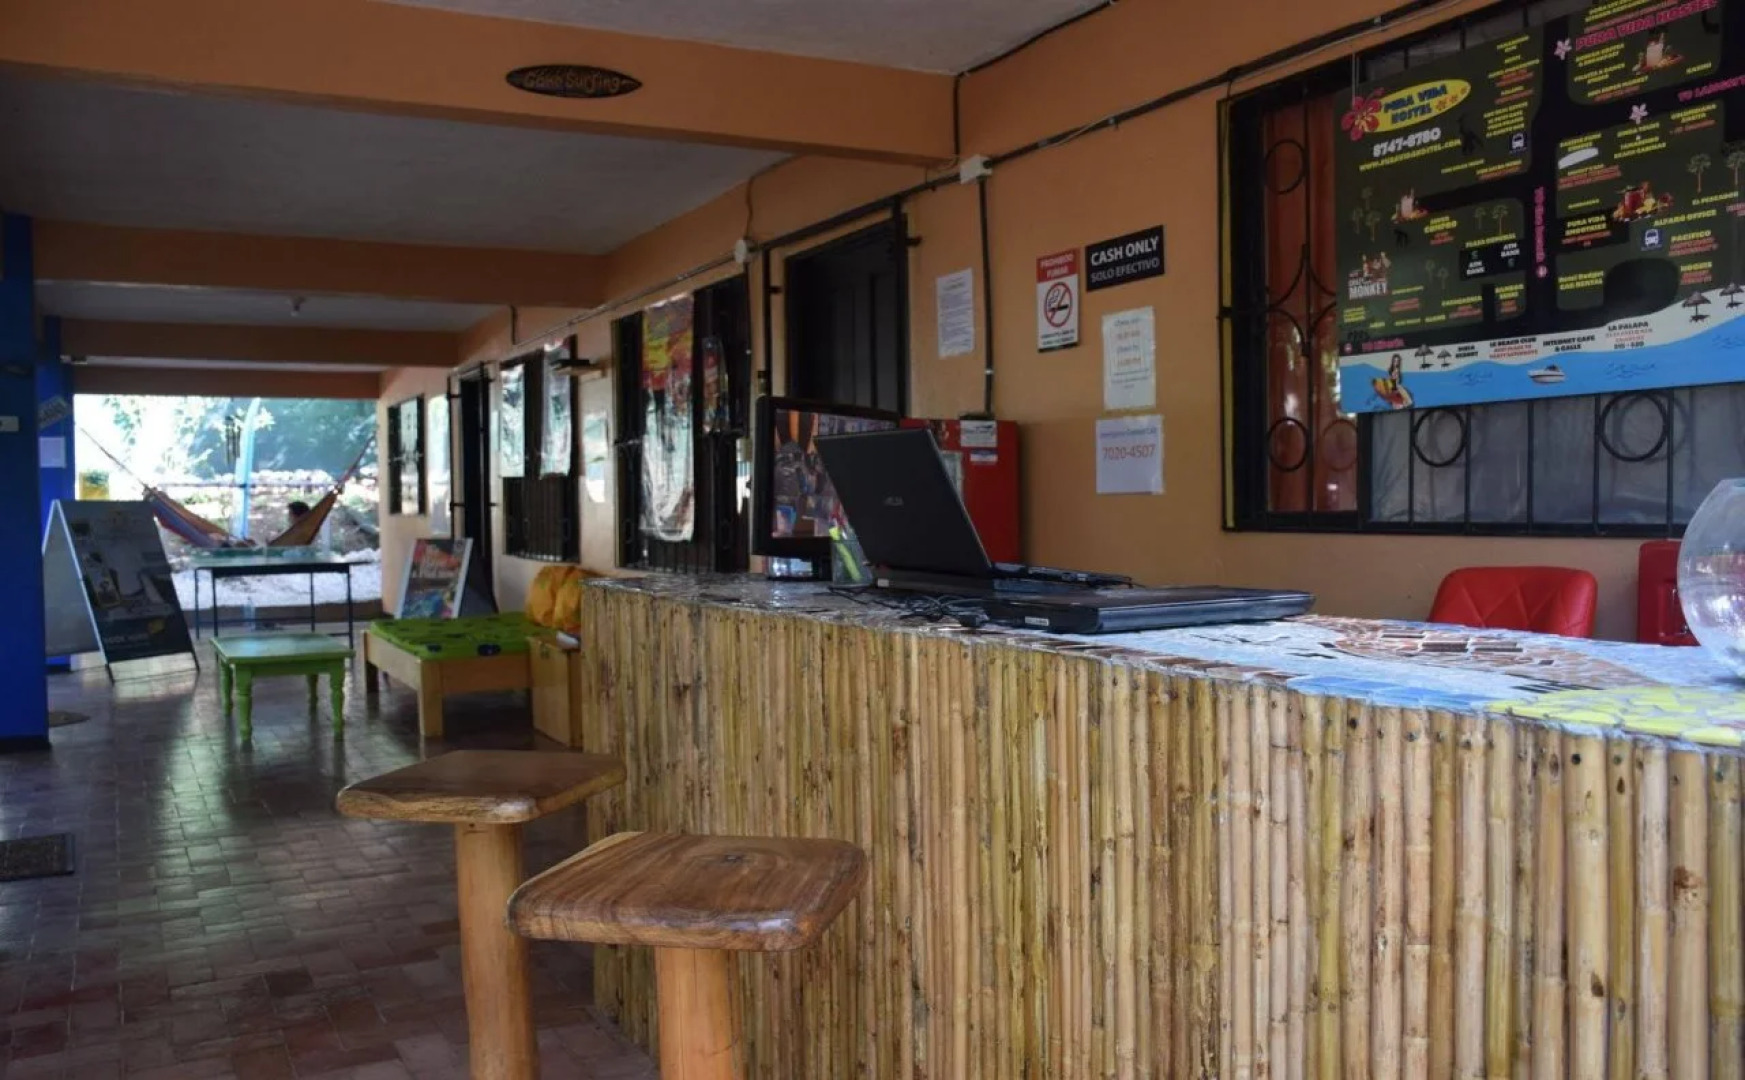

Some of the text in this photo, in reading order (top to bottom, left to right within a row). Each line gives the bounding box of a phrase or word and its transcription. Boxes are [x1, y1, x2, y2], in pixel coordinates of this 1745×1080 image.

[1384, 84, 1448, 112] PURA VIDA
[1392, 104, 1432, 124] HOSTEL
[1090, 236, 1159, 266] CASH ONLY
[1090, 257, 1160, 284] SOLO EFECTIVO
[1349, 282, 1388, 300] MONKEY
[1102, 444, 1156, 460] 7020-4507
